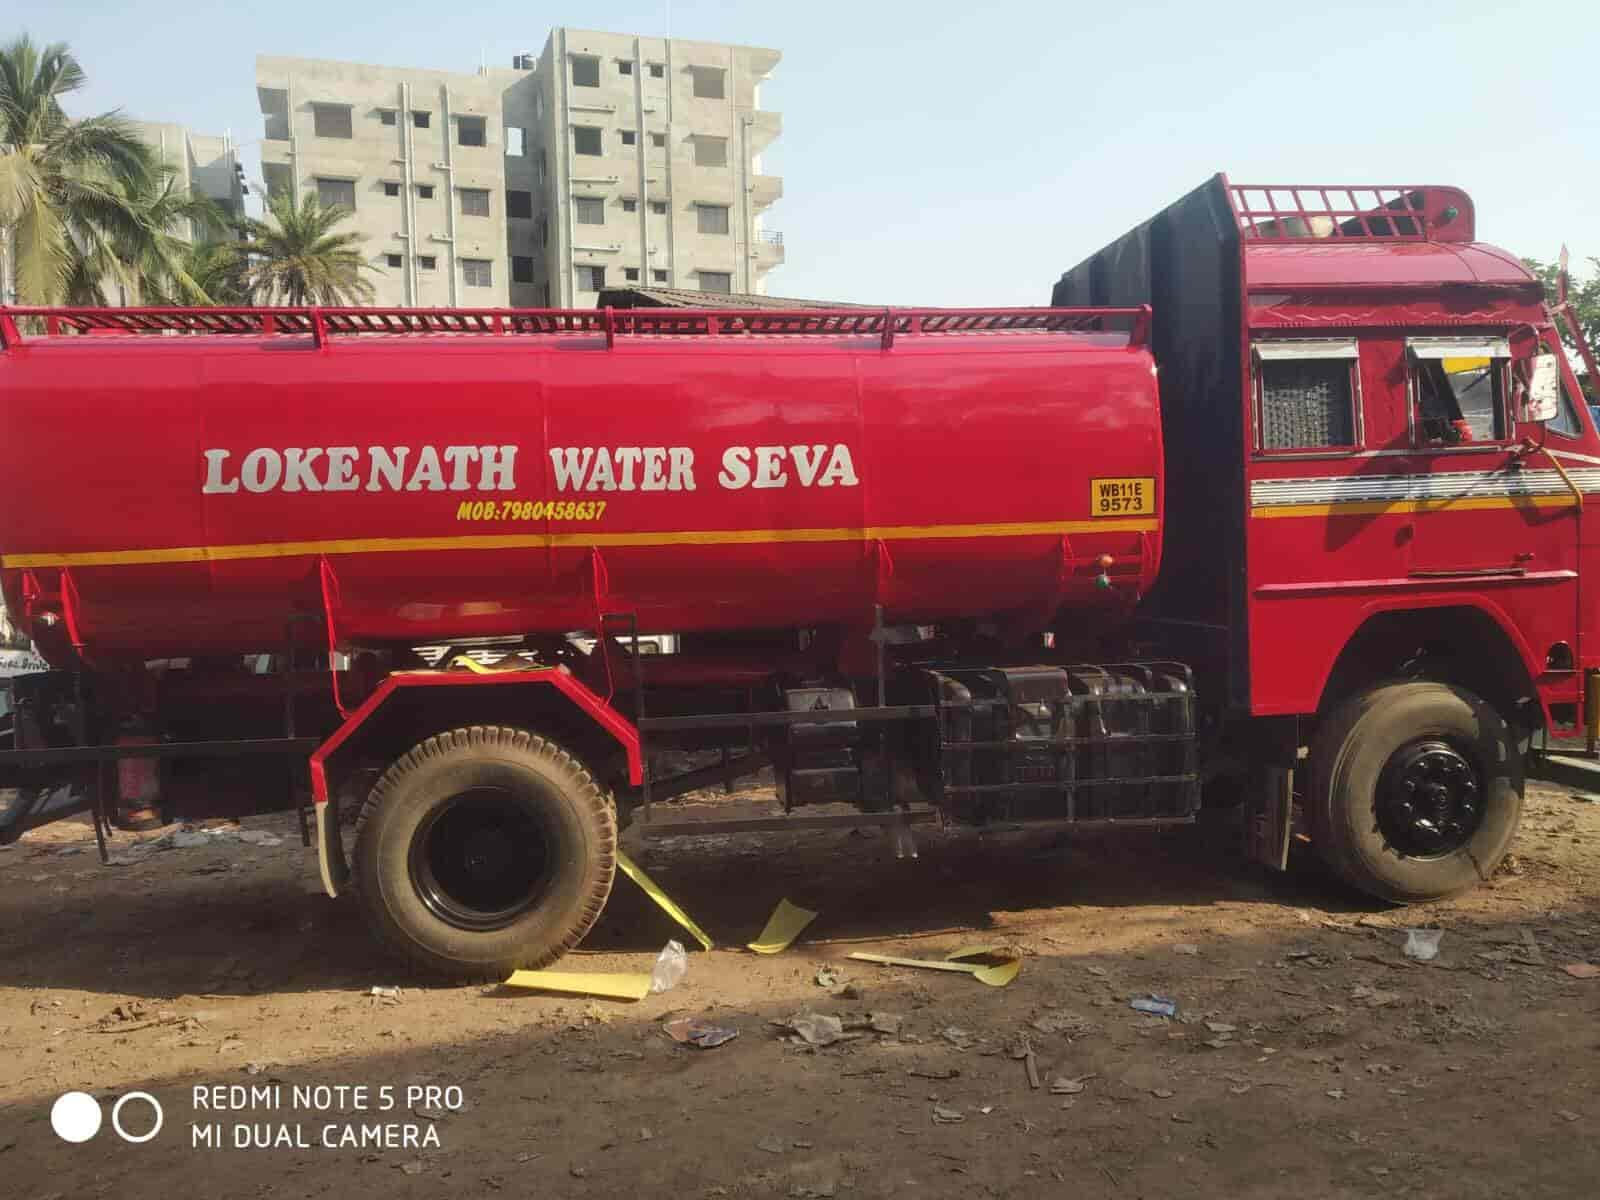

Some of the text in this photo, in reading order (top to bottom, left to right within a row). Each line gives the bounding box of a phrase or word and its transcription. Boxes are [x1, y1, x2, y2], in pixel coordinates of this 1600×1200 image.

[202, 443, 859, 494] LOKENATH WATER SEVA
[1099, 482, 1143, 497] WB11E
[456, 500, 607, 521] MOB:7980458637
[1100, 497, 1143, 512] 9573
